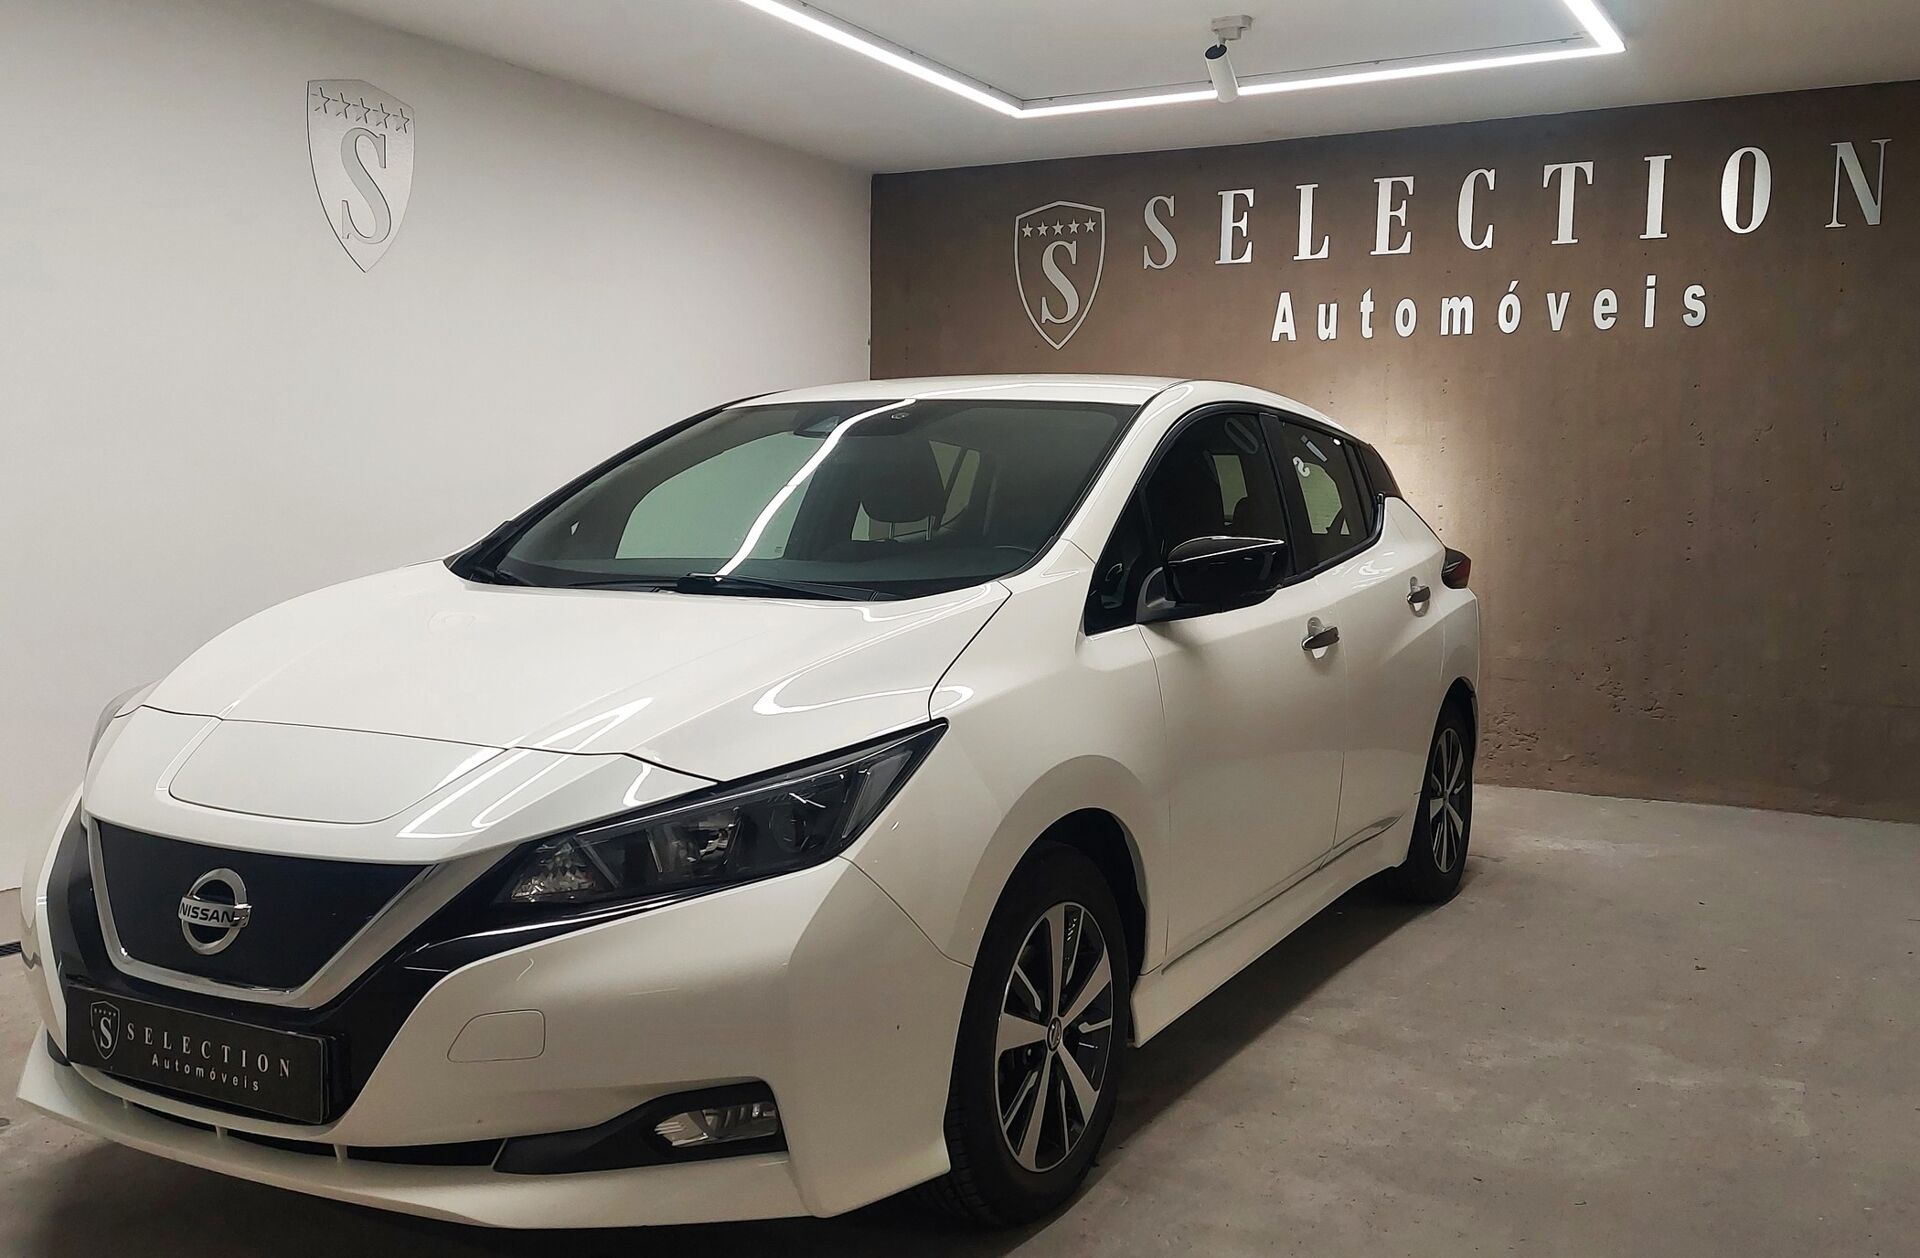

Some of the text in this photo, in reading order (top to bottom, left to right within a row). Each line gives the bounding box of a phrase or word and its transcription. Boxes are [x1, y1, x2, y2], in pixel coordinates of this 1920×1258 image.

[340, 127, 391, 244] S
[1142, 138, 1892, 270] SELECTION
[1040, 239, 1078, 325] S
[1271, 275, 1707, 342] Automóveis
[179, 902, 236, 923] NISSAN
[99, 1016, 112, 1049] S
[127, 1023, 290, 1077] SELECTION
[152, 1053, 259, 1091] Automóveis
